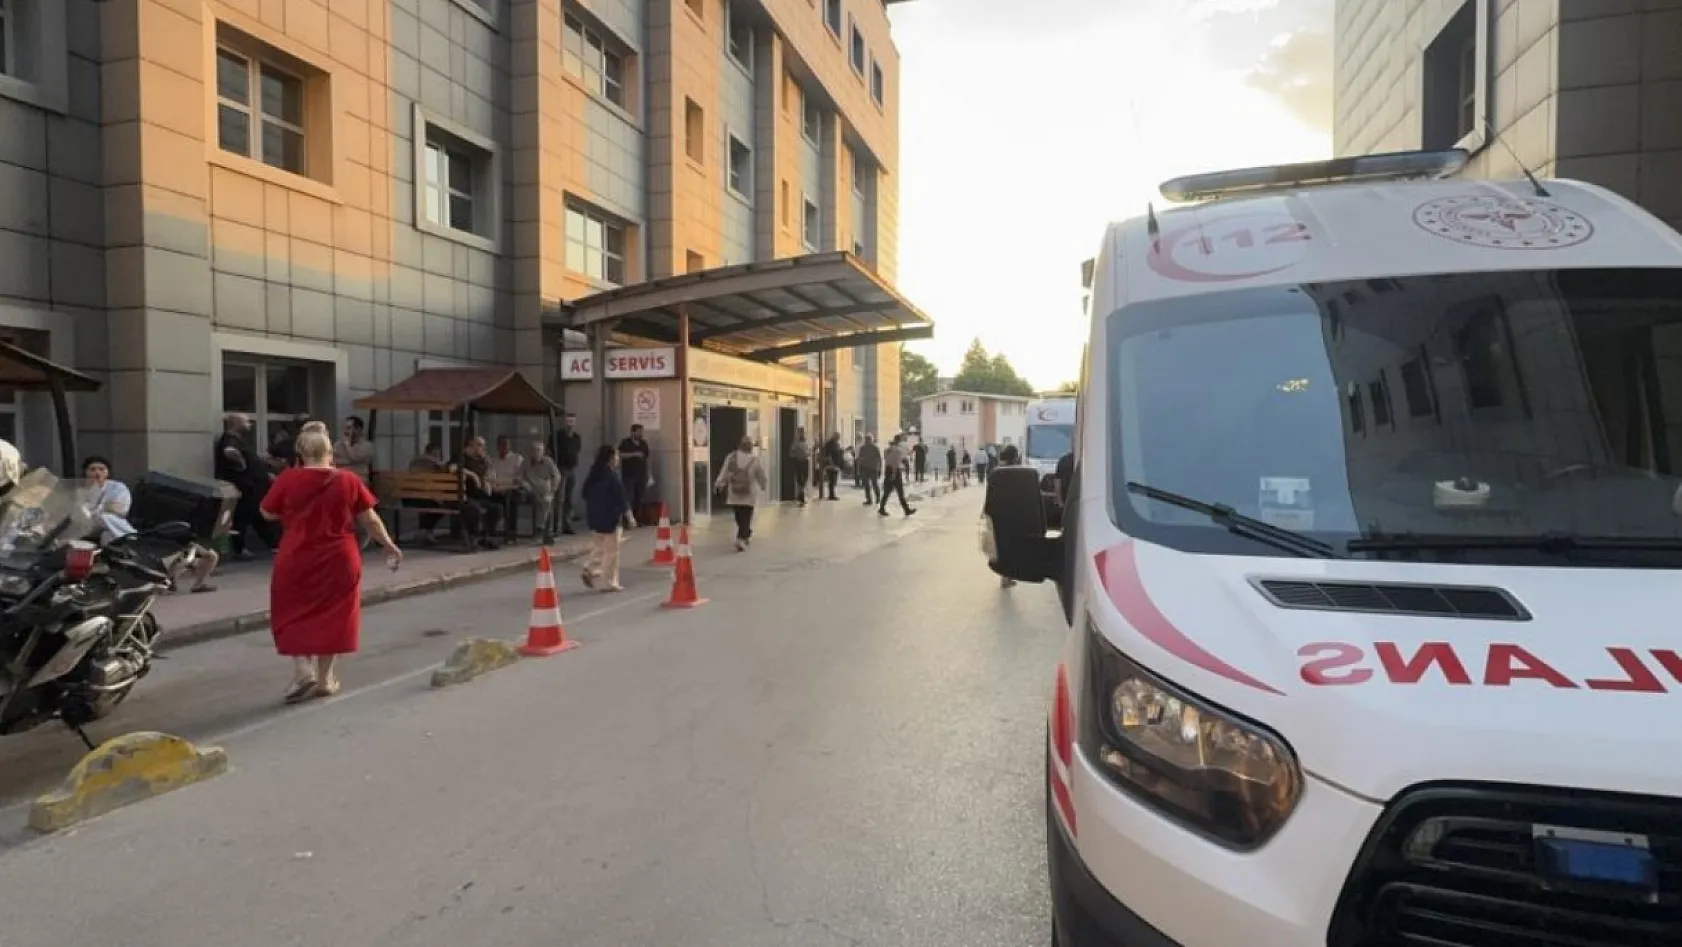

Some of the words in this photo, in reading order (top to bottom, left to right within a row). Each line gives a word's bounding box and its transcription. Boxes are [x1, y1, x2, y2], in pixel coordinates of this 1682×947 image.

[1181, 221, 1311, 255] 112
[570, 357, 592, 373] AC
[608, 354, 666, 371] SERVİS
